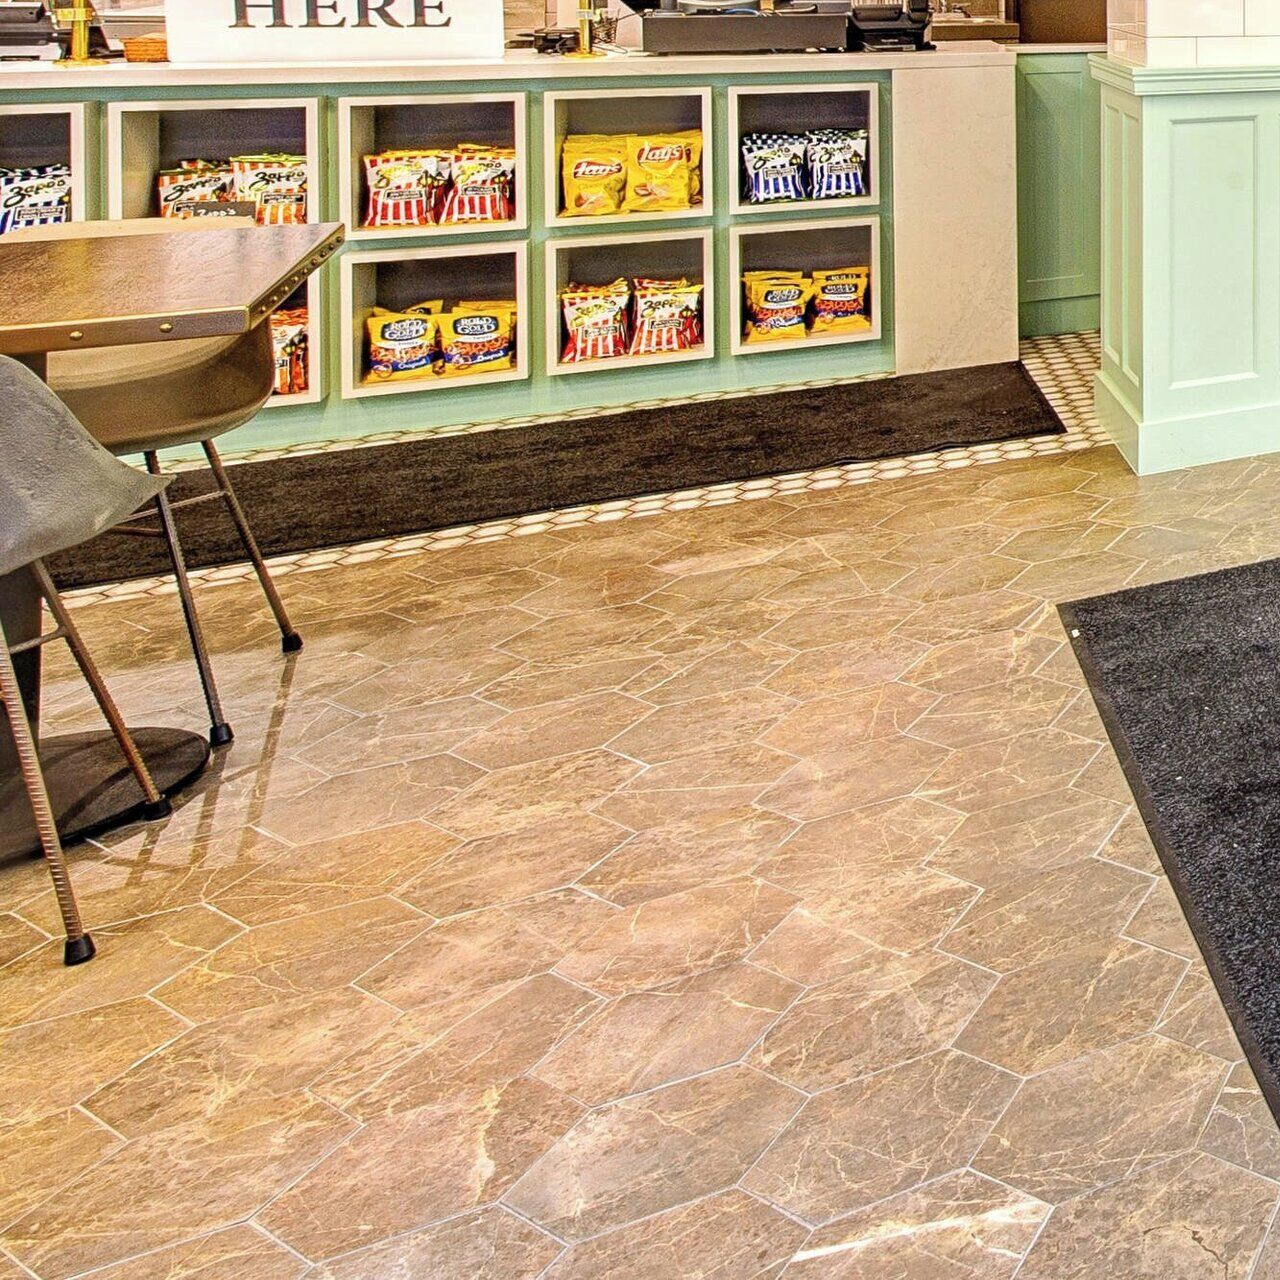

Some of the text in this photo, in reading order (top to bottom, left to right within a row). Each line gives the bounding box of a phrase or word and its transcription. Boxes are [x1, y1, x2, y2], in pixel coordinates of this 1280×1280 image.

[460, 315, 492, 326] ROLD
[384, 326, 425, 341] GOLD
[456, 324, 496, 336] GOLD
